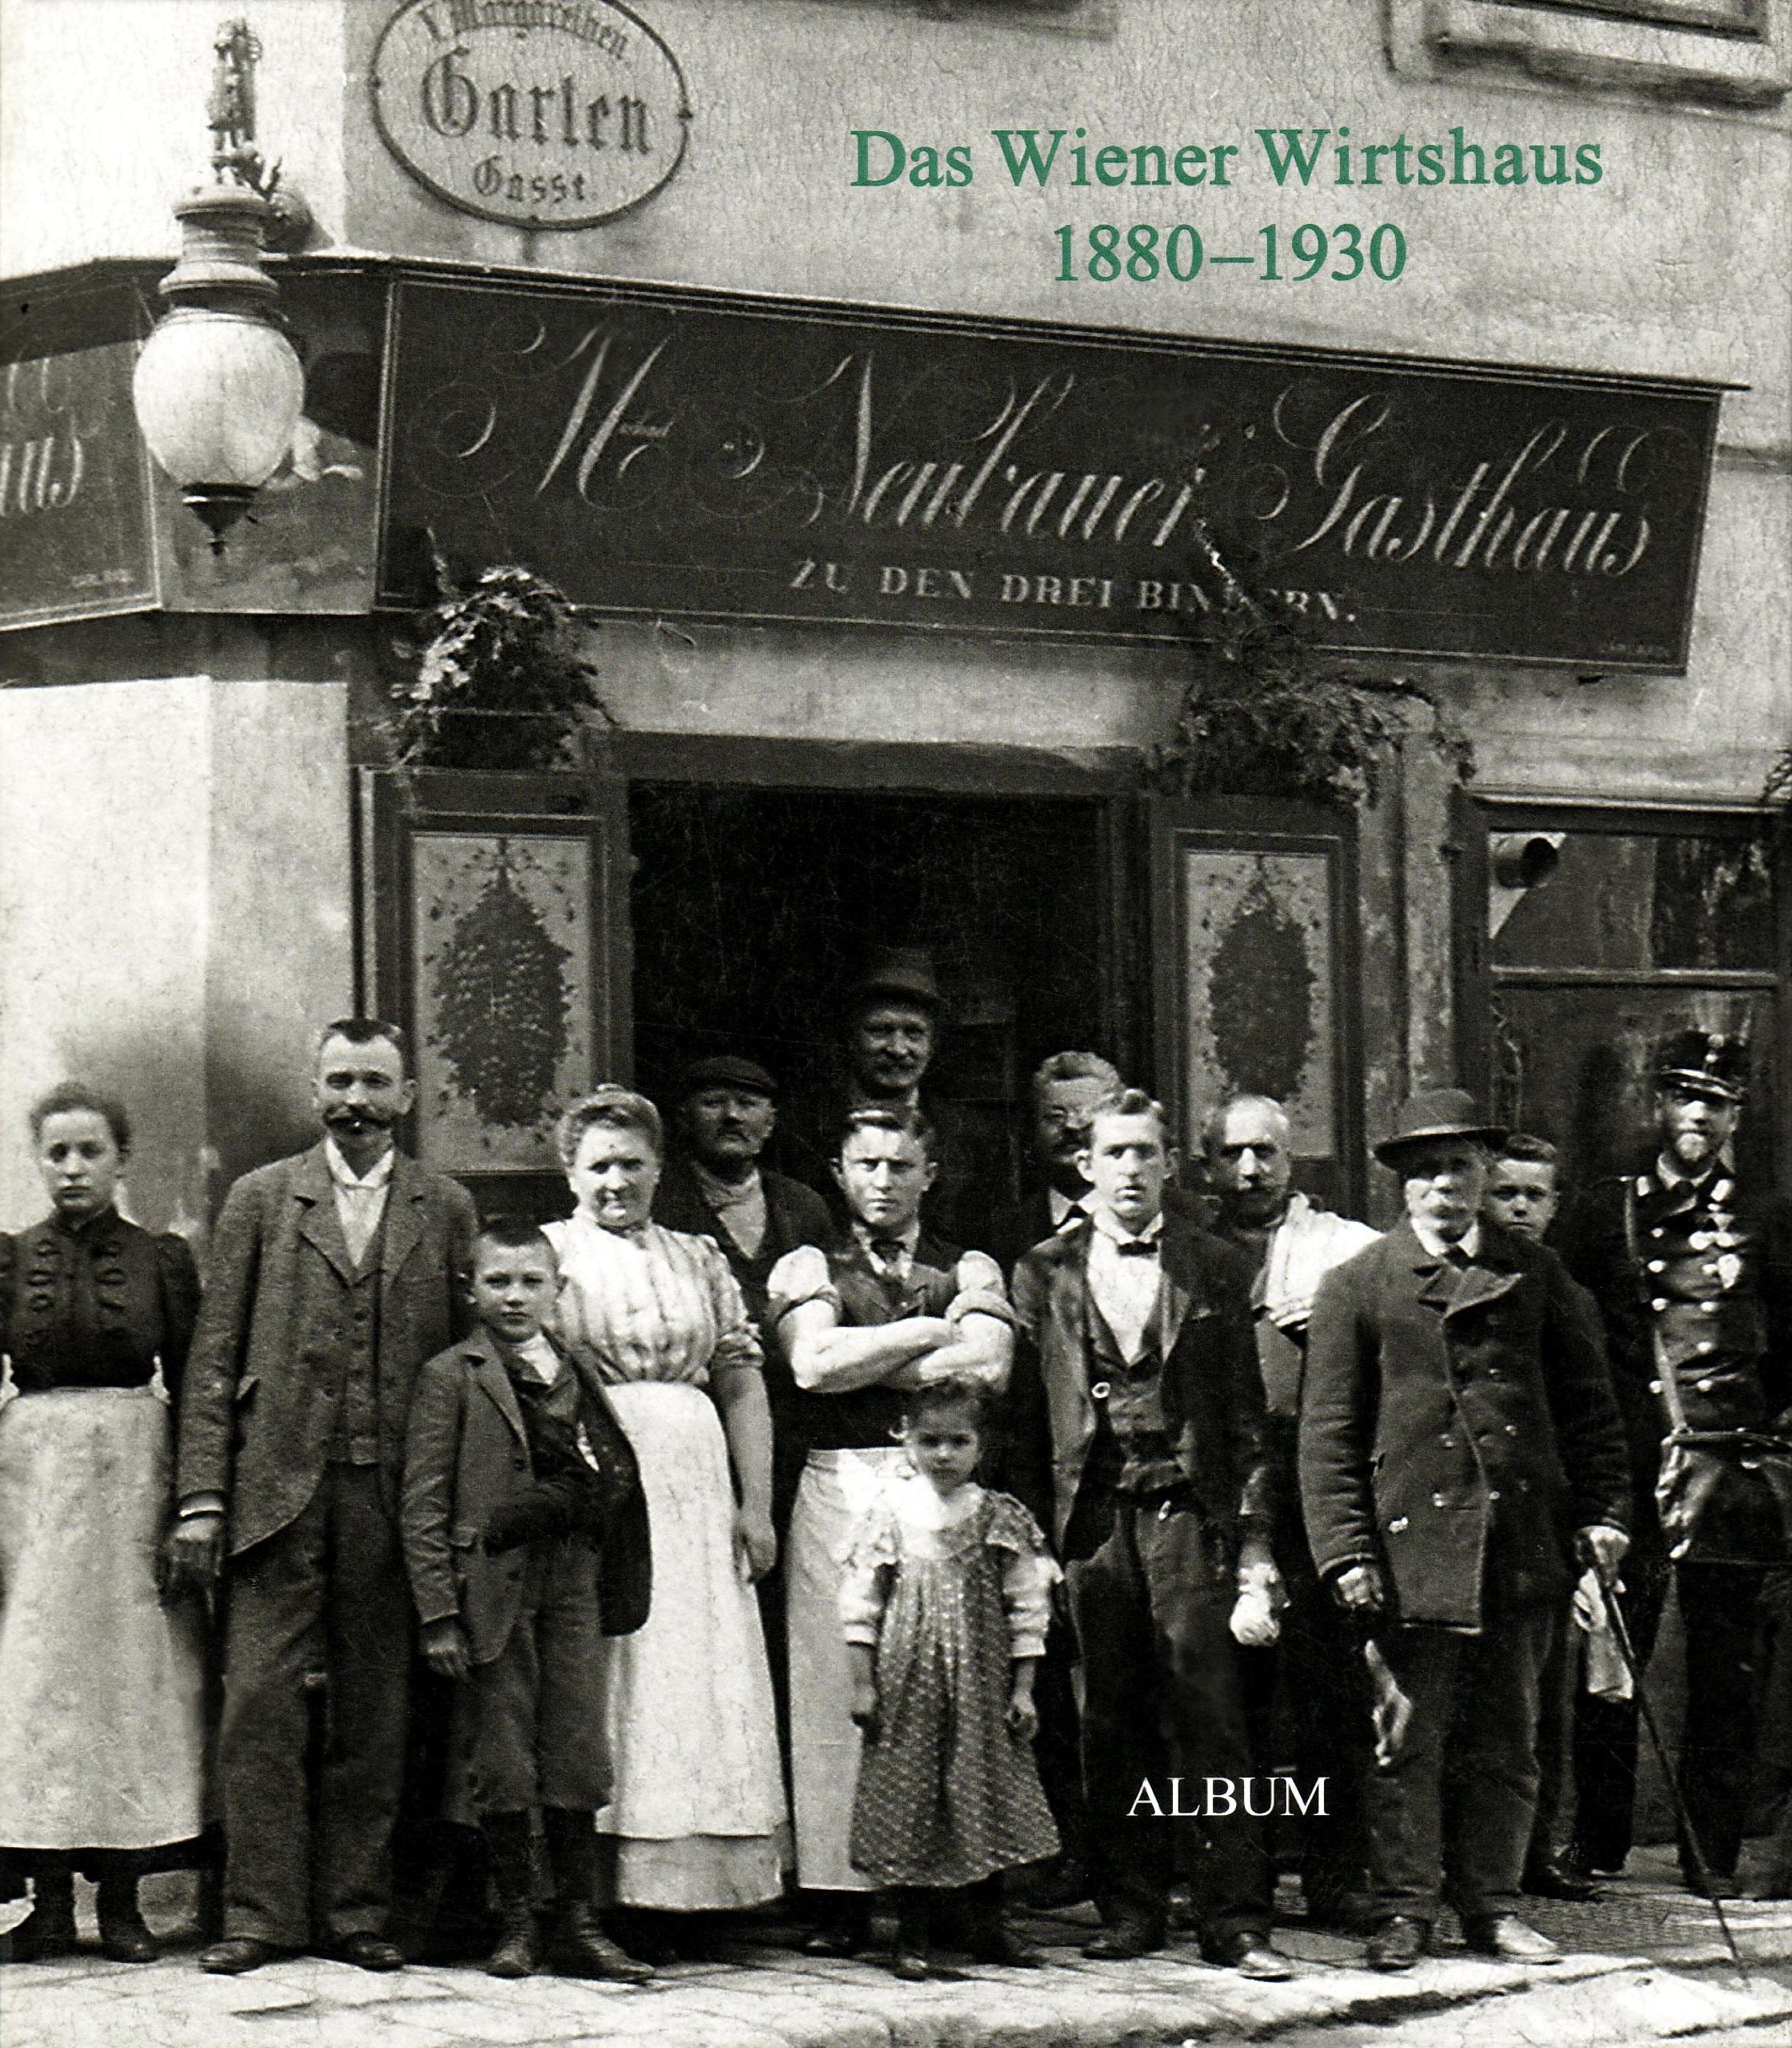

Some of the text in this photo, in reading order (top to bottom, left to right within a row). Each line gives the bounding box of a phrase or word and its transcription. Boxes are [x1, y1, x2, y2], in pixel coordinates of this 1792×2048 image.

[422, 46, 650, 155] Garten
[1248, 382, 1653, 578] Gasthaus
[791, 559, 1356, 622] ZU DEN DREI BINRN.
